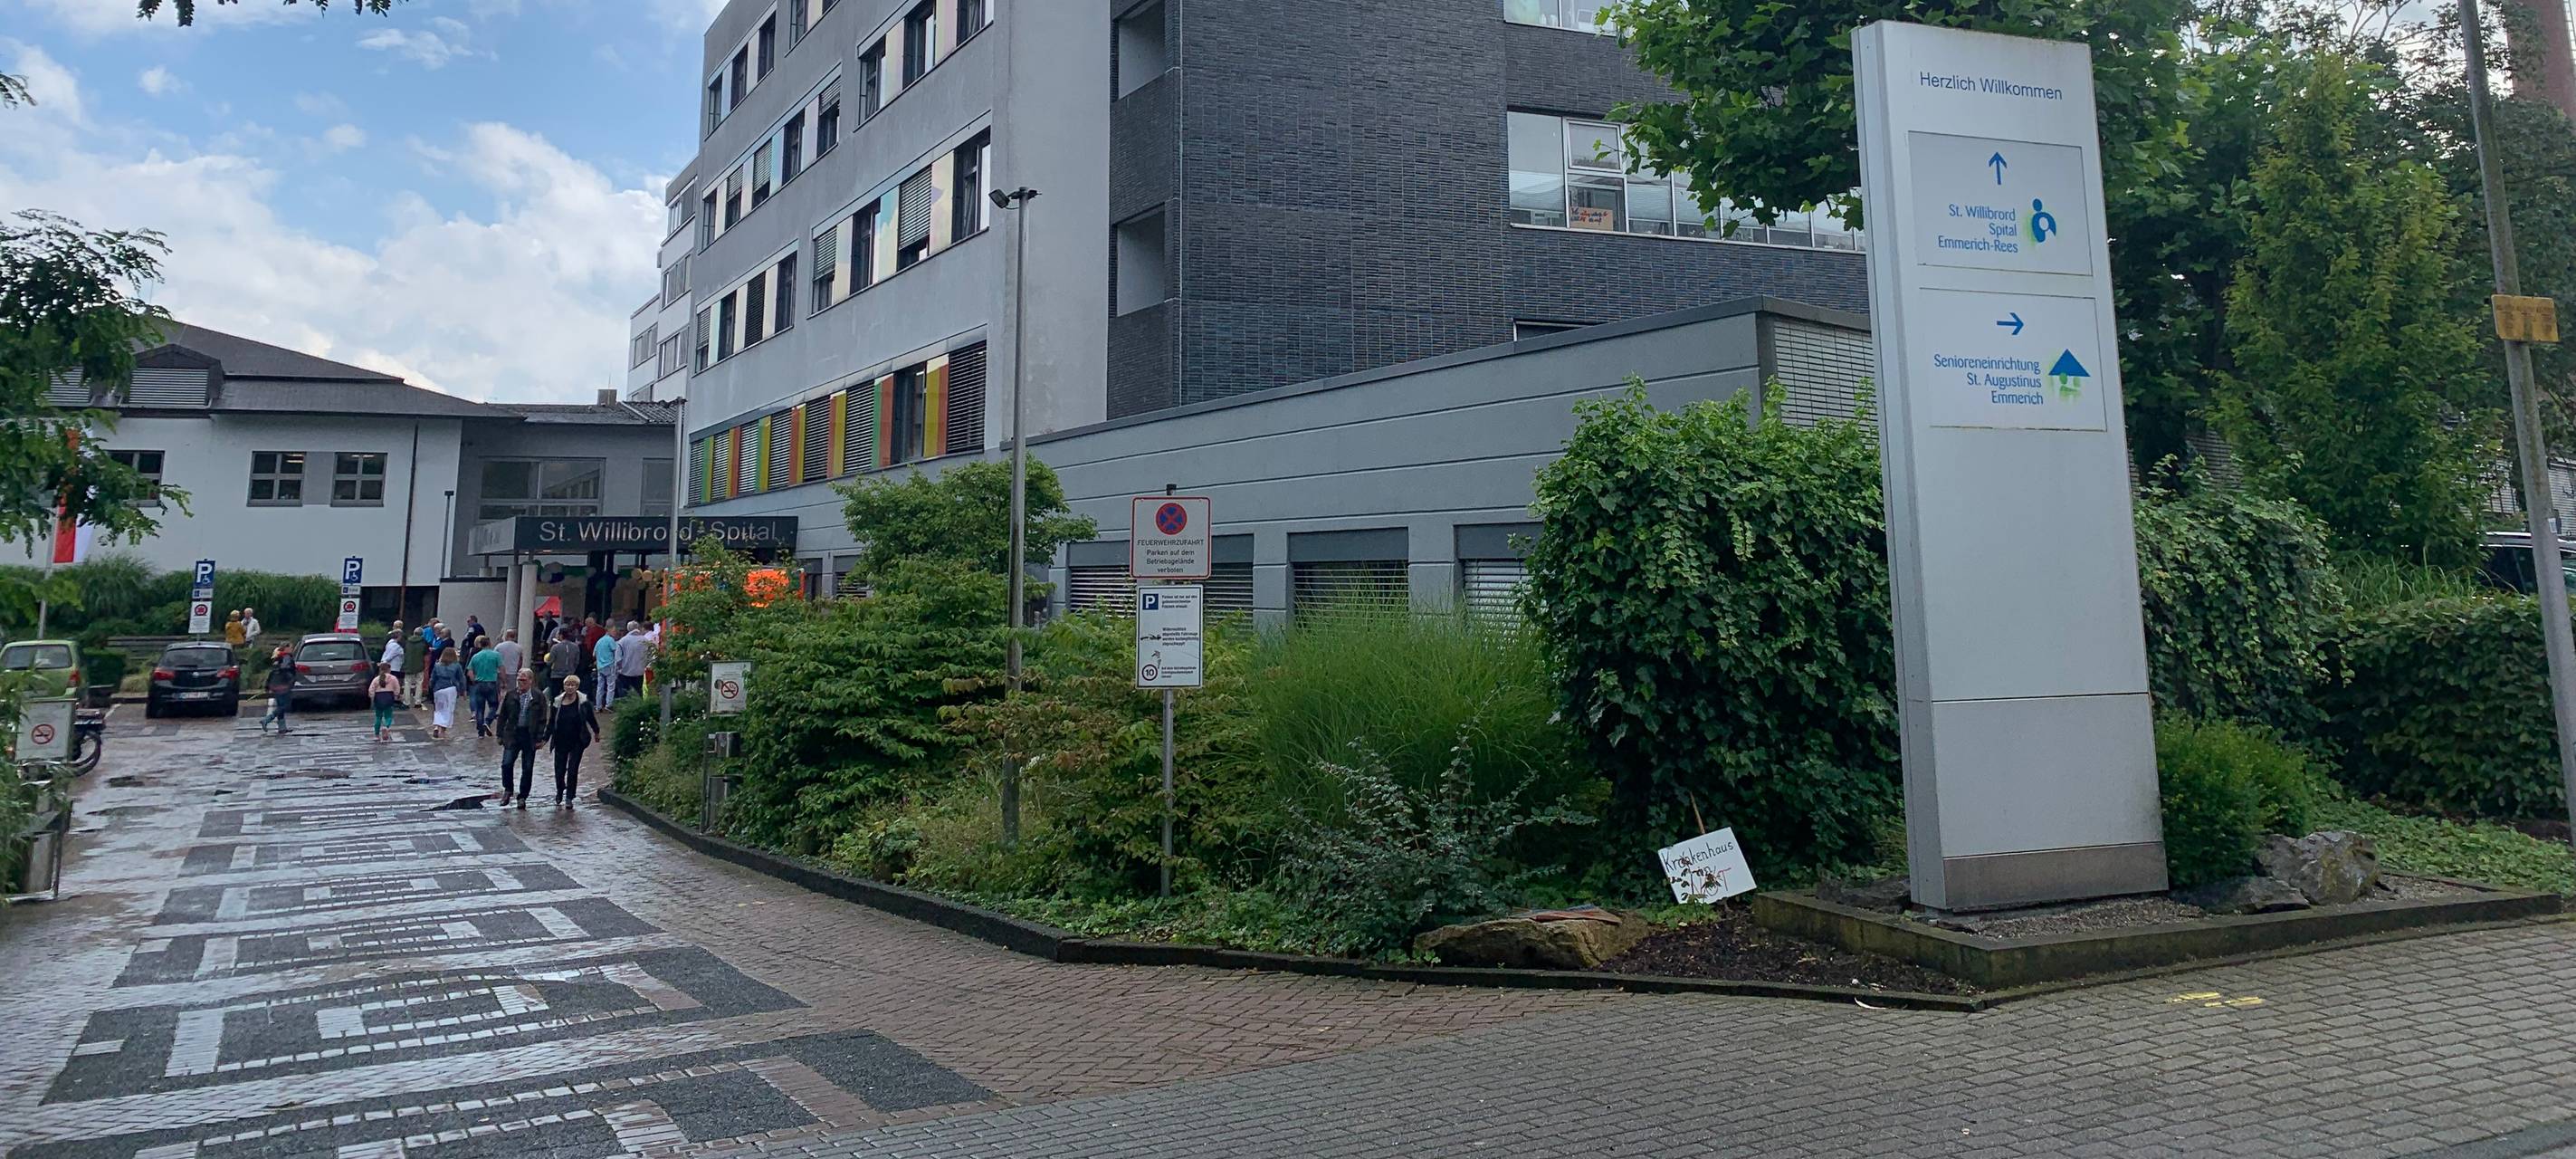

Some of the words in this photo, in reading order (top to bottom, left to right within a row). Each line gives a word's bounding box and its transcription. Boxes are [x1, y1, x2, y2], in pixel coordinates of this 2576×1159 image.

[1920, 71, 1976, 91] Herzlich
[1980, 77, 2063, 101] Willkommen
[1949, 204, 1962, 217] St.
[1965, 206, 2016, 221] Willibrord
[1989, 222, 2018, 238] Spital
[1938, 235, 2018, 254] Emmerich-Rees
[1933, 353, 2040, 375] Senioreneinrichtung
[1967, 372, 1981, 386] St.
[1984, 373, 2042, 390] Augustinus
[1991, 390, 2044, 405] Emmerich
[539, 521, 571, 541] St.
[1145, 669, 1155, 677] 10
